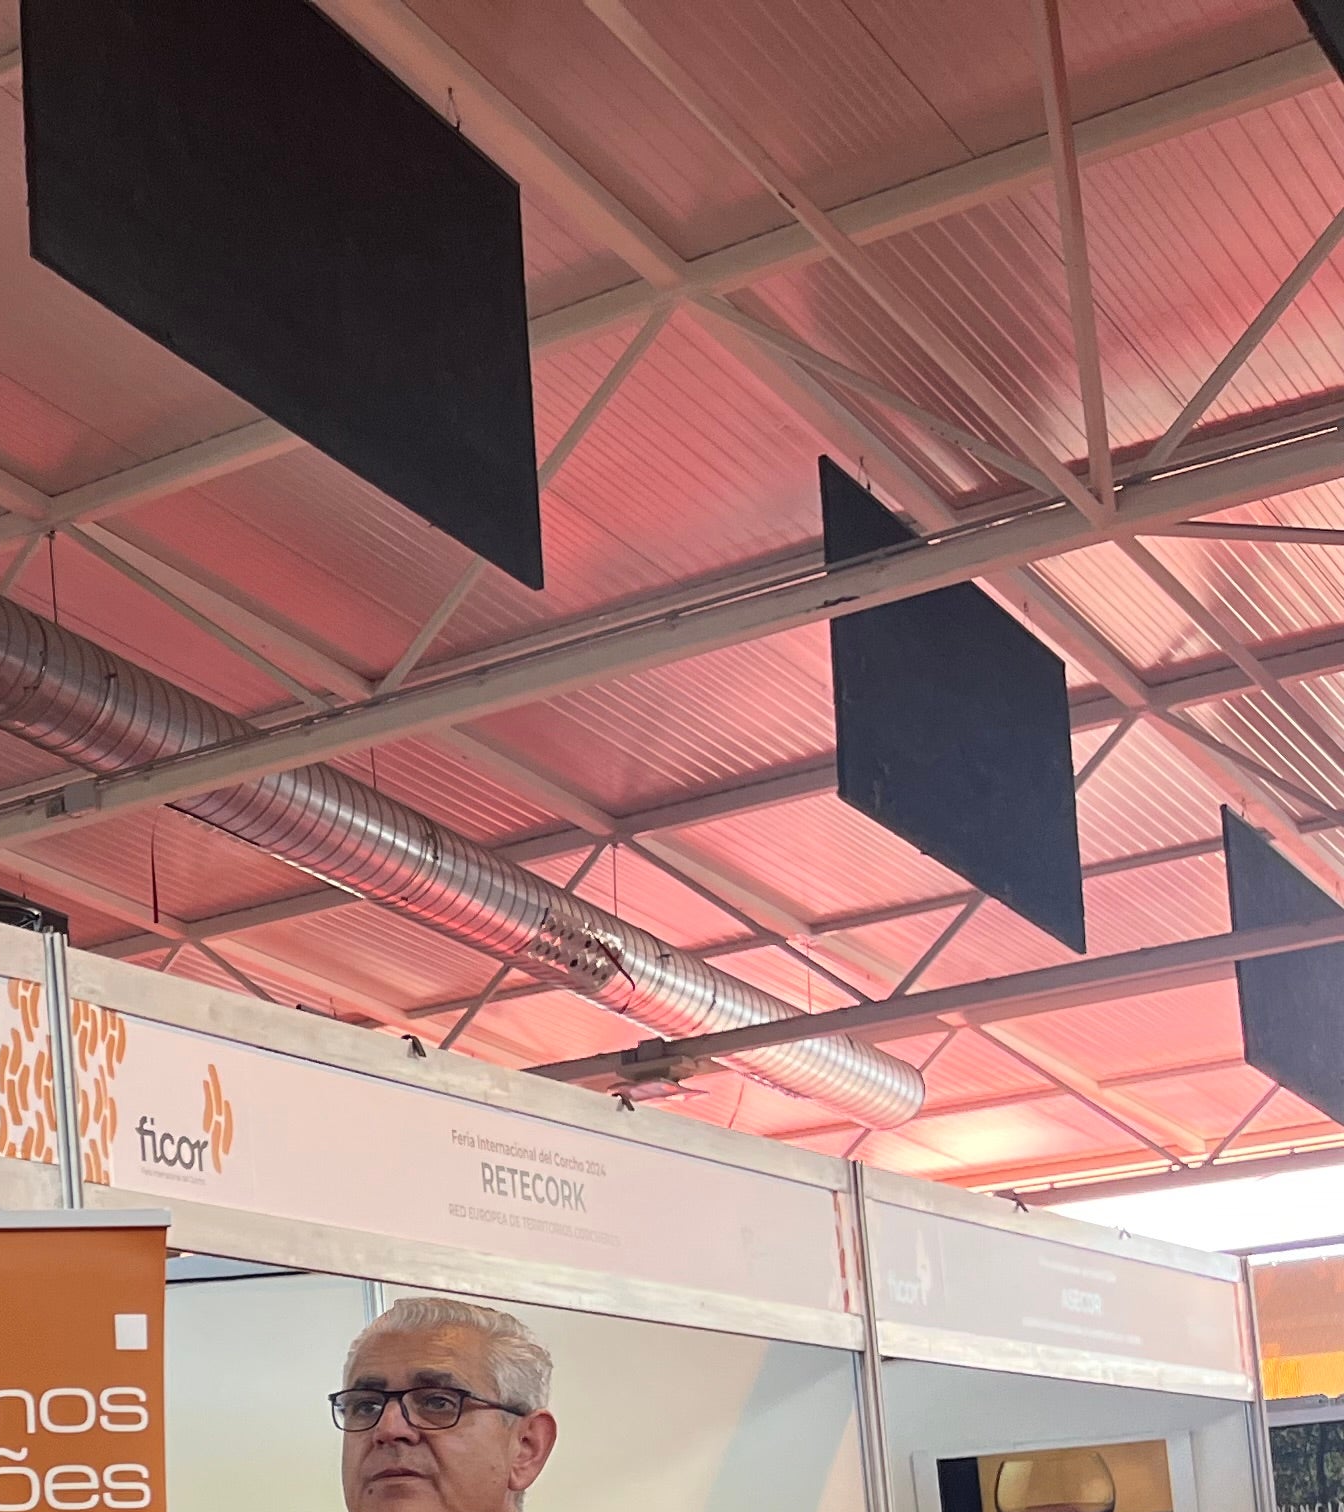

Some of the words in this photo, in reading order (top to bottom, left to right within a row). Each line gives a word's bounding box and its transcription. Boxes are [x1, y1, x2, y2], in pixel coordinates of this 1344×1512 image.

[135, 1115, 209, 1172] ficor
[451, 1129, 475, 1148] Feria
[476, 1135, 537, 1162] Internacional
[538, 1150, 553, 1165] del
[553, 1152, 585, 1173] Corcho
[585, 1160, 607, 1177] 2024
[481, 1161, 587, 1214] RETECORK
